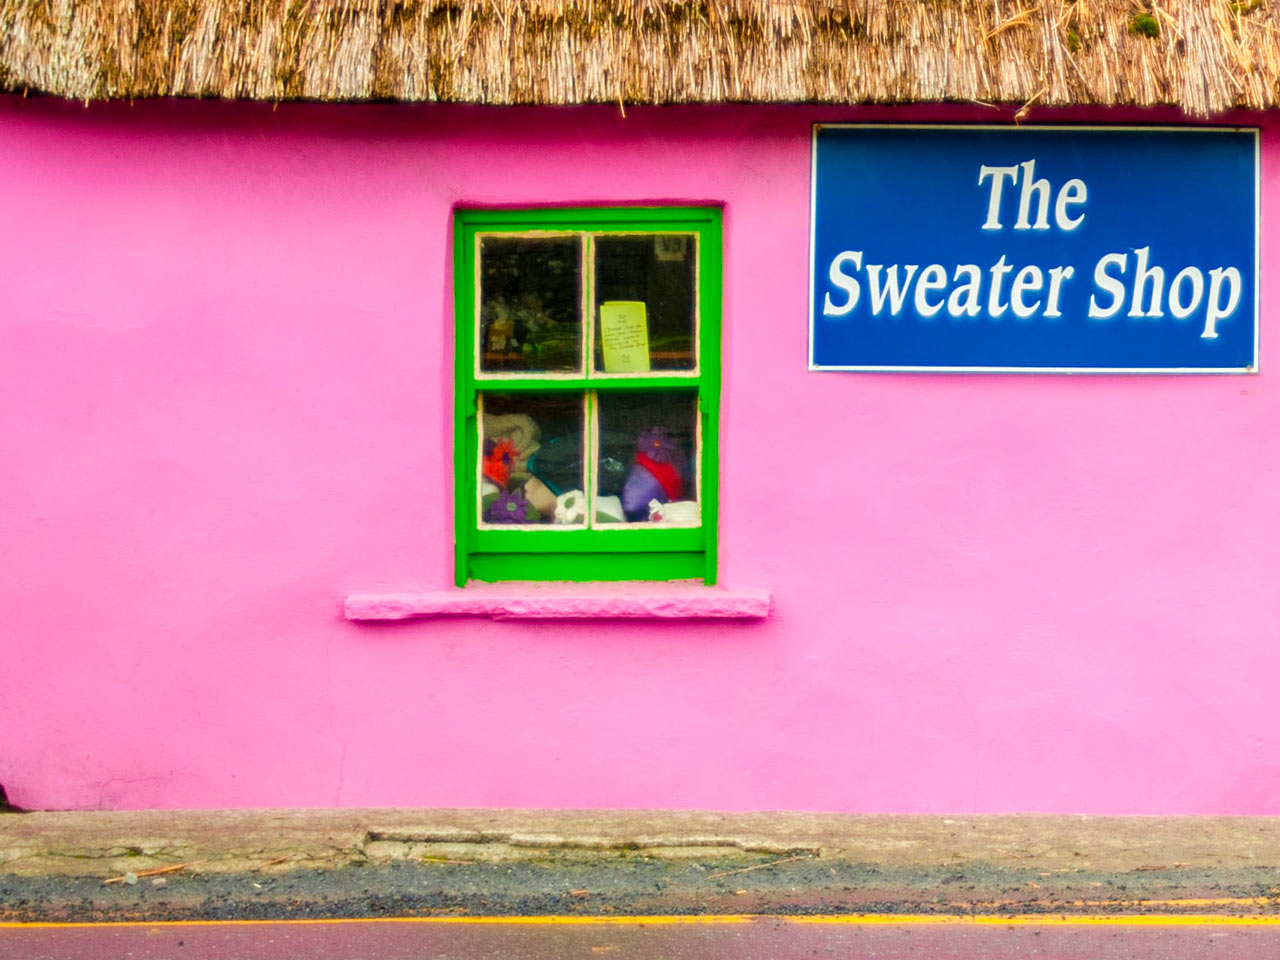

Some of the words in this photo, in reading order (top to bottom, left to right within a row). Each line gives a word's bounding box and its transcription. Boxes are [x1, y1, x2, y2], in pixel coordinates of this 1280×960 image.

[978, 159, 1088, 231] The
[823, 250, 1074, 318] Sweater
[1088, 246, 1242, 339] Shop
